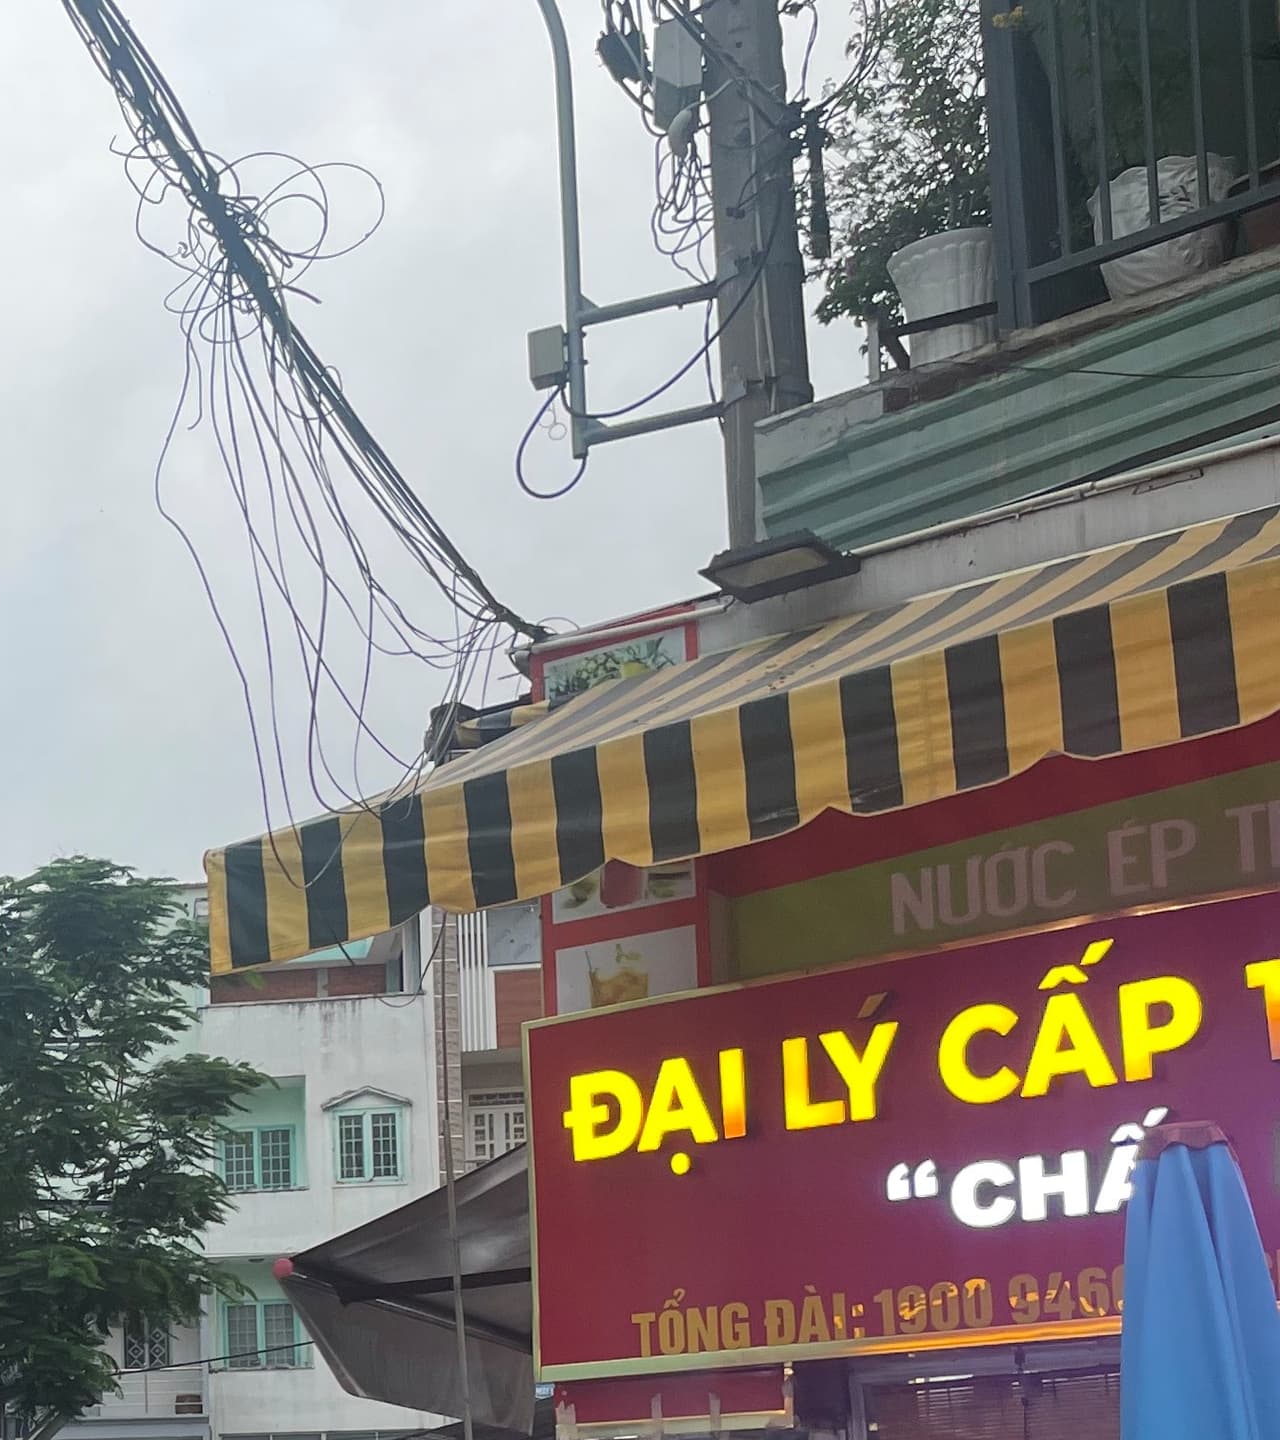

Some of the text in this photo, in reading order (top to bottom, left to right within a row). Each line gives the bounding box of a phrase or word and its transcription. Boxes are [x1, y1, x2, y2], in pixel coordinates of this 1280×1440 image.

[1106, 814, 1199, 897] ÉP
[562, 1047, 749, 1177] ĐẠI
[781, 991, 899, 1132] LÝ
[938, 938, 1203, 1106] CẤP
[630, 1286, 750, 1359] TỔNG
[762, 1283, 866, 1349] ĐÀI:
[873, 1277, 993, 1336] 1900
